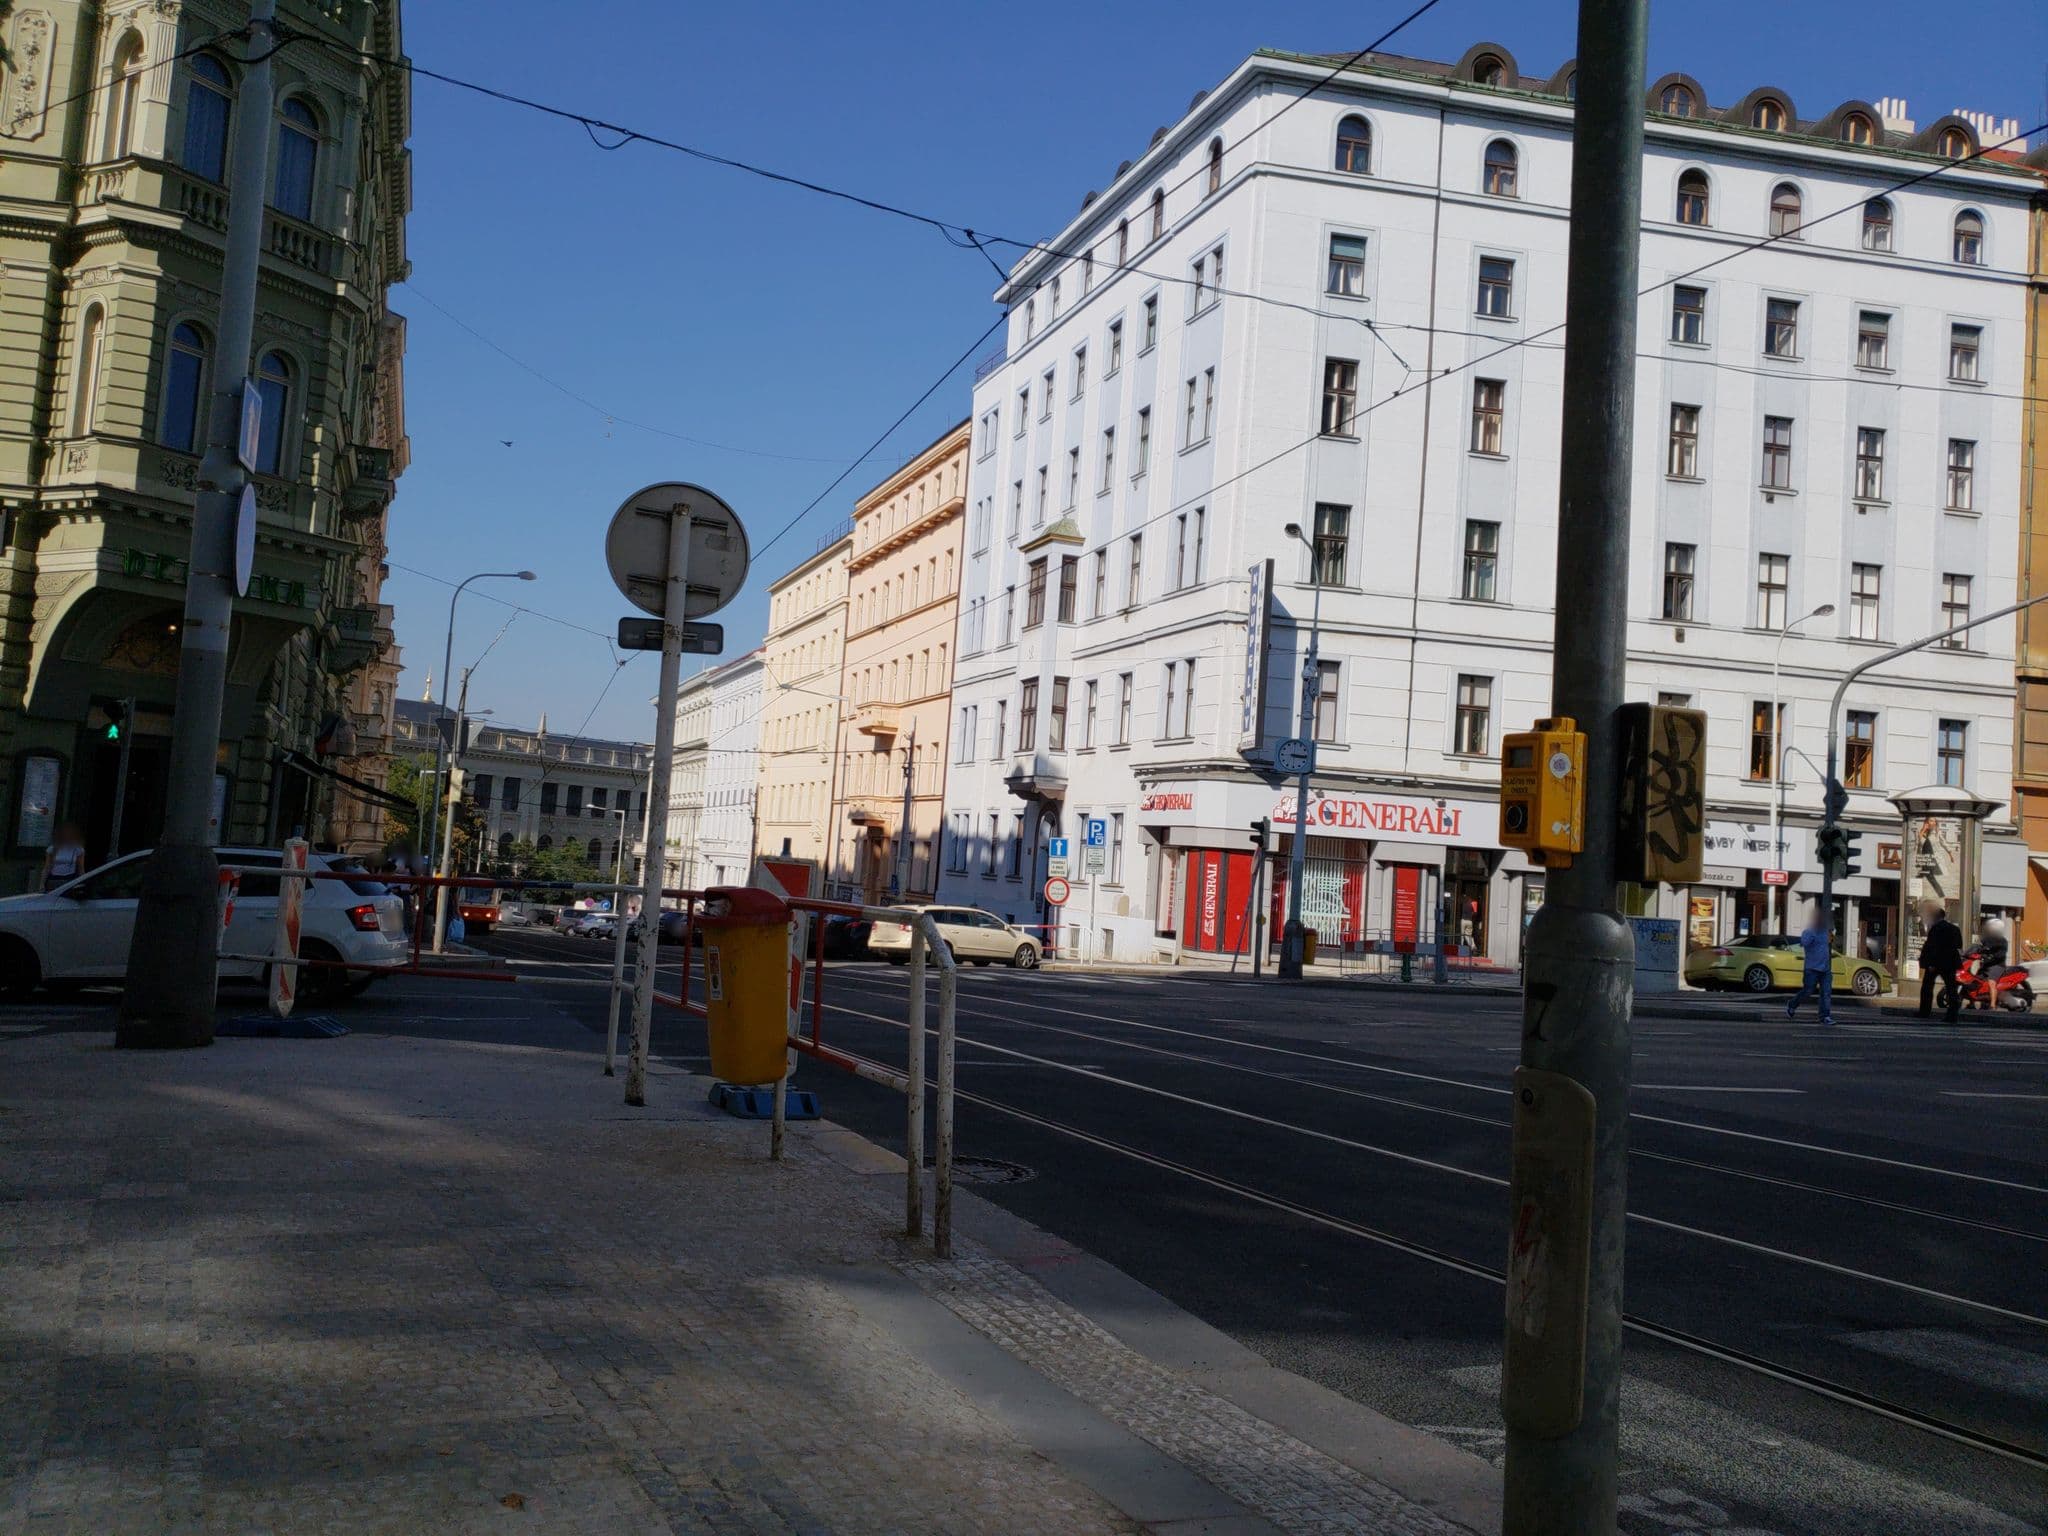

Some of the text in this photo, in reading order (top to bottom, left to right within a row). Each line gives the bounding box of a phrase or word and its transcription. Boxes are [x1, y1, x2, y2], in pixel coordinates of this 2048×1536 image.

[1244, 577, 1258, 728] KOUPELNY
[1153, 793, 1193, 811] GENERALI
[1318, 799, 1462, 836] GENERALI
[1091, 822, 1102, 838] P
[1204, 863, 1218, 918] GENERALI
